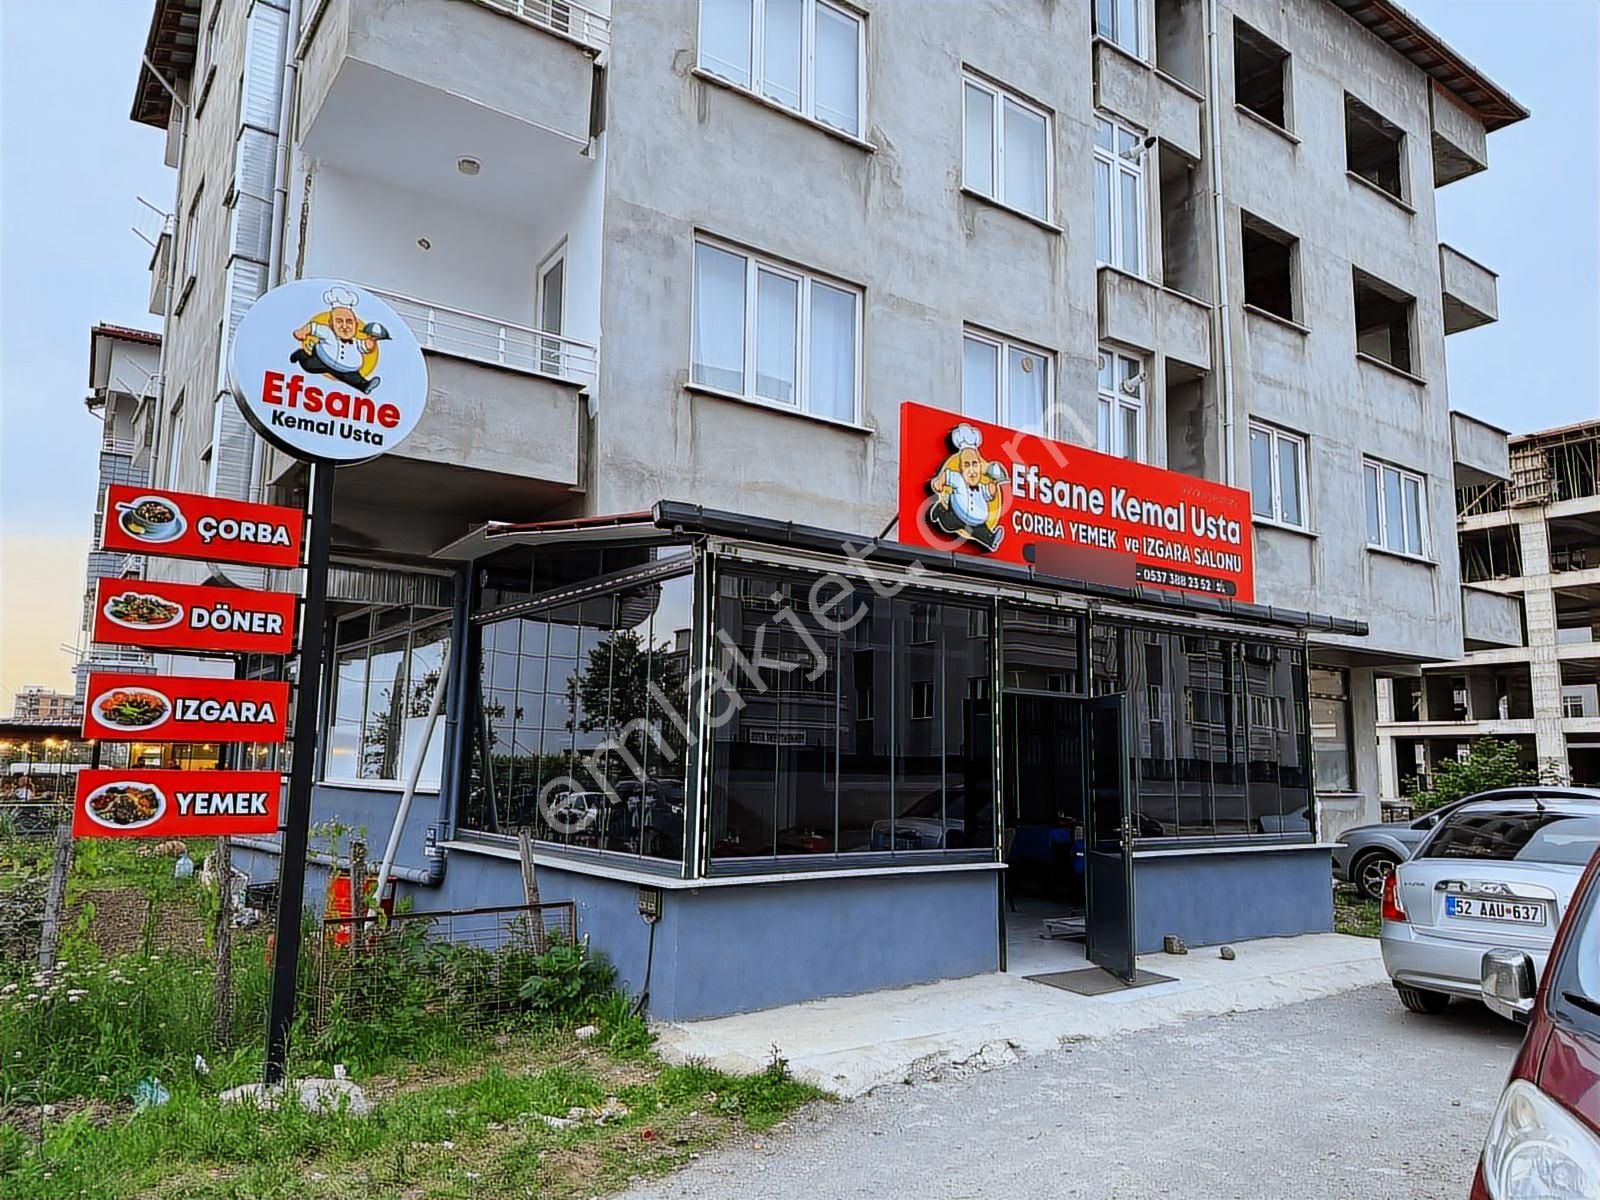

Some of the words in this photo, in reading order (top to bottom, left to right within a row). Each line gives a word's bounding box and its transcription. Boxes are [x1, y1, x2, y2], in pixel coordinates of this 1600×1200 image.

[262, 371, 400, 428] Efsane
[272, 410, 334, 436] Kemal
[340, 423, 383, 446] Usta
[1012, 463, 1104, 515] Efsane
[1111, 487, 1185, 532] Kemal
[1191, 506, 1241, 544] Usta
[197, 517, 290, 545] ÇORBA
[1012, 511, 1064, 539] ÇORBA
[1070, 522, 1116, 549] YEMEK
[1125, 538, 1139, 553] ve
[1143, 537, 1191, 564] IZGARA
[1194, 551, 1242, 573] SALONU
[1143, 569, 1167, 583] 0537
[1188, 576, 1199, 589] 23
[1200, 579, 1212, 591] 52
[191, 604, 282, 634] DÖNER
[175, 699, 275, 723] IZGARA
[176, 793, 267, 815] YEMEK
[1456, 900, 1472, 915] 52
[1480, 902, 1505, 918] AAU
[1513, 905, 1539, 920] 637
